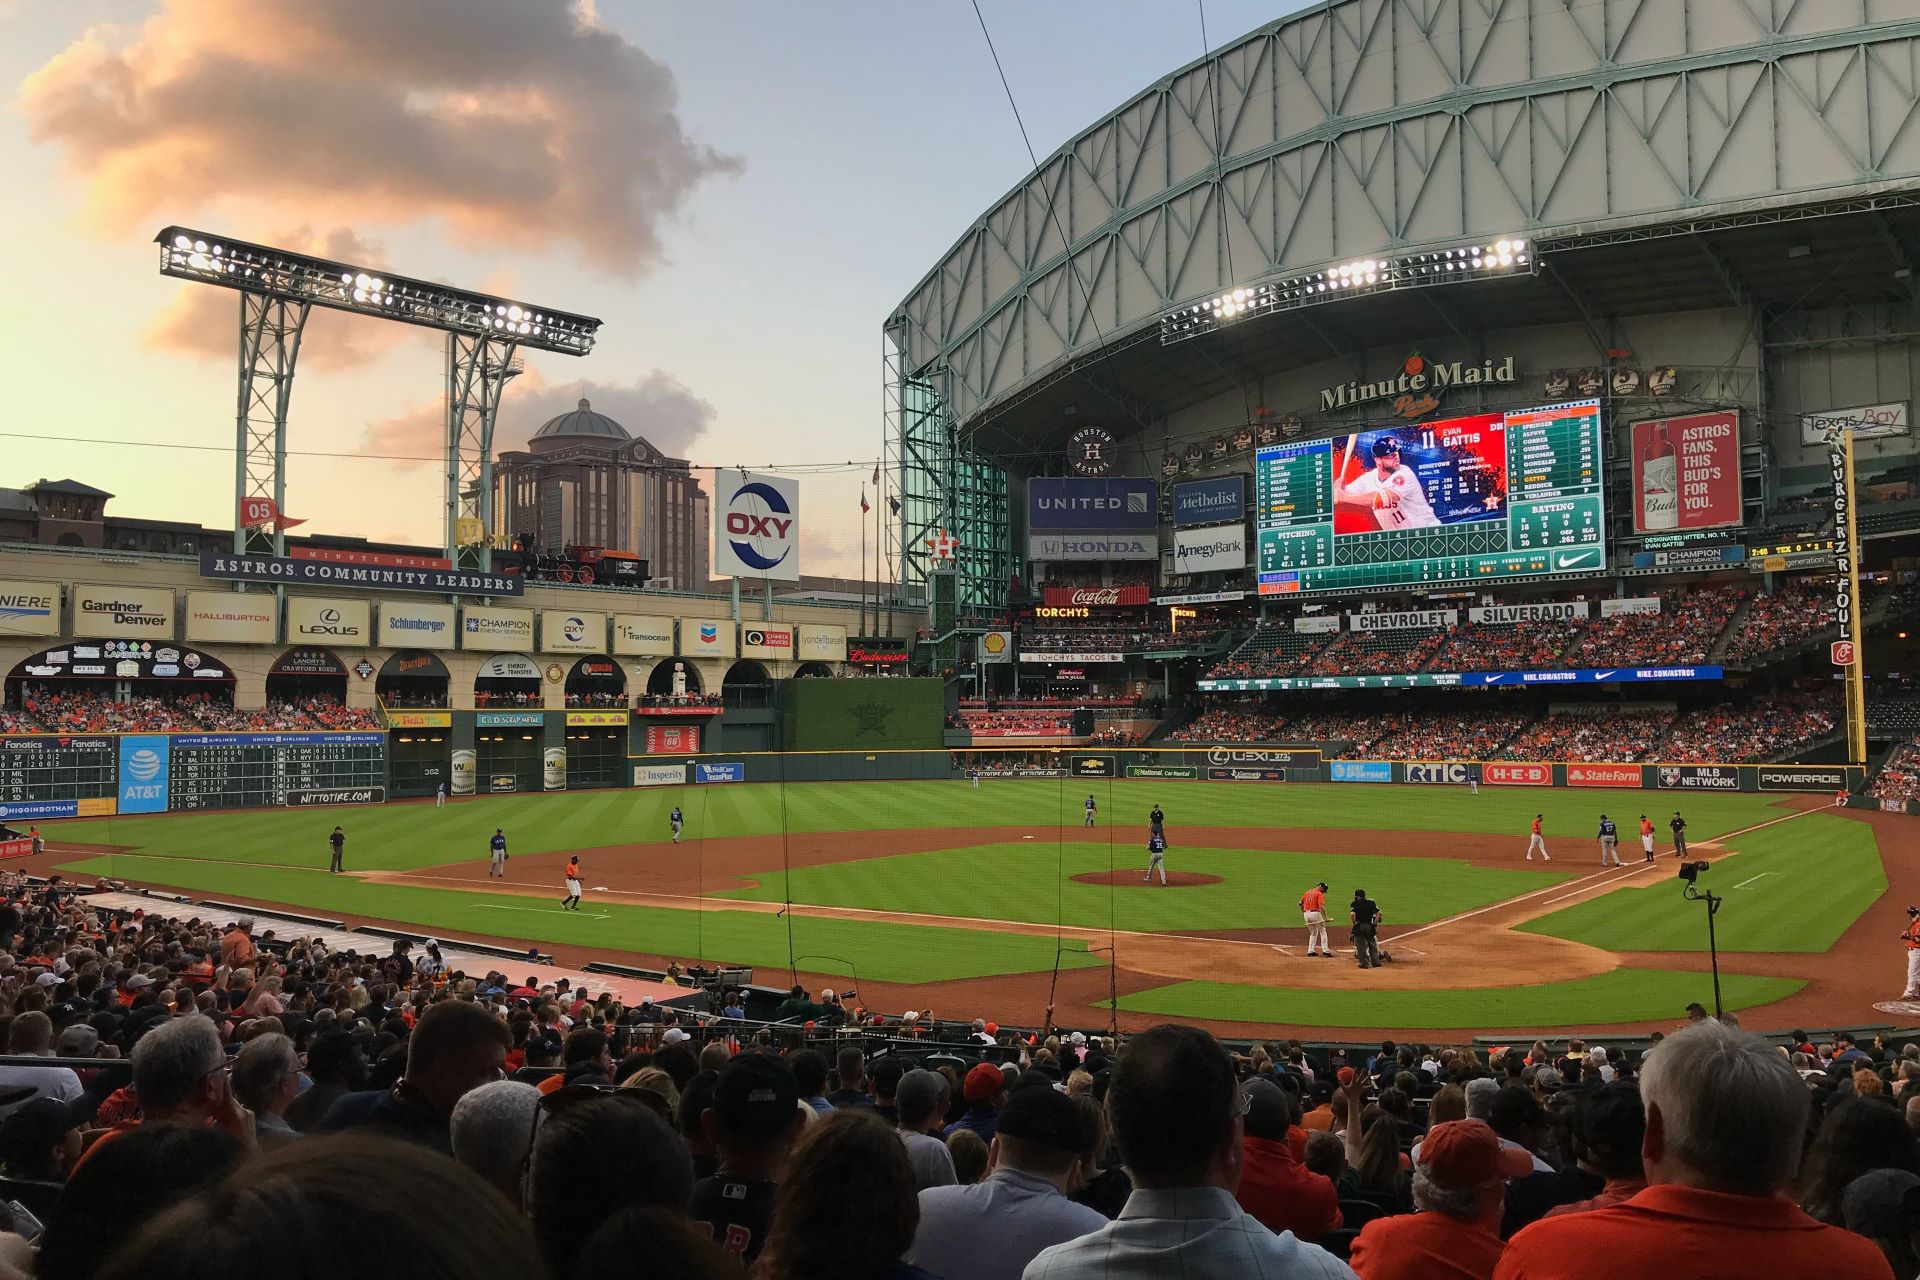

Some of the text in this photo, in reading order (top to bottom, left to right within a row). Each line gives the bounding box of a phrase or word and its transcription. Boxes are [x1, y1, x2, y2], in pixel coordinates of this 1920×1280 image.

[1319, 356, 1517, 413] Minute Maid
[1809, 408, 1900, 431] Texas Bay
[1443, 427, 1461, 437] EVAN
[1490, 423, 1504, 431] DH
[1682, 424, 1731, 440] ASTROS
[1073, 428, 1112, 443] HOUSTON
[1422, 430, 1435, 449] 11
[1443, 433, 1480, 447] GATTIS
[1083, 443, 1101, 460] H
[1279, 448, 1309, 457] TEXAS
[1682, 440, 1717, 454] FANS,
[1075, 461, 1110, 474] ASTROS
[1683, 454, 1711, 468] THIS
[1683, 467, 1721, 482] BUD'S
[1684, 483, 1708, 496] FOR
[1038, 497, 1121, 510] UNITED
[1179, 491, 1238, 510] Methodist
[1684, 497, 1713, 510] YOU.
[1830, 453, 1848, 554] BURGERZ
[248, 503, 270, 519] 05
[1531, 502, 1575, 514] BATTING
[461, 524, 479, 538] 17
[726, 512, 793, 539] OXY
[1278, 529, 1316, 540] PITCHING
[1559, 536, 1575, 544] .262
[1581, 534, 1597, 542] .277
[1645, 534, 1682, 543] DESIGNATED
[1062, 542, 1147, 553] HONDA
[1177, 540, 1241, 559] AmegyBank
[1669, 549, 1721, 559] CHAMPION
[1776, 545, 1792, 554] TEX
[309, 551, 438, 567] MINUTE MAID
[1751, 562, 1764, 570] the
[1785, 556, 1825, 568] generation
[213, 558, 515, 591] ASTROS COMMUNITY LEADERS
[1266, 583, 1291, 592] ASTROS
[0, 595, 52, 608] NIERE
[1072, 589, 1120, 605] Coca-Cola
[82, 599, 143, 613] Gardner
[1036, 607, 1089, 618] TORCHYS
[1835, 579, 1851, 638] FOUL
[113, 613, 167, 626] Denver
[194, 612, 270, 622] HALLIBURTON
[1359, 611, 1447, 629] CHEVROLET
[1482, 604, 1575, 624] SILVERADO
[390, 616, 445, 633] Schlumberger
[480, 618, 530, 629] CHAMPION
[564, 625, 585, 633] OXY
[299, 624, 359, 637] LEXUS
[628, 631, 671, 642] Transocean
[103, 650, 152, 659] LANDRY'S
[849, 650, 909, 663] Budweiser
[293, 658, 326, 666] LANDRY'S
[1523, 672, 1576, 682] NIKE.COM/ASTROS
[1637, 669, 1695, 678] NIKE.COM/ASTROS
[501, 716, 540, 724] SCRAP METAL
[1002, 728, 1041, 737] Budweiser
[5, 739, 107, 749] Fanatics Fanatics
[666, 737, 678, 746] 66
[424, 768, 440, 776] 362
[648, 770, 683, 781] Insperity
[1406, 763, 1467, 782] RTIC
[1493, 768, 1542, 780] H-E-B
[1660, 767, 1679, 775] MLB
[1696, 767, 1721, 777] MLB
[1681, 776, 1736, 787] NETWORK
[1761, 774, 1842, 784] POWERADE
[124, 785, 163, 801] AT&T
[300, 790, 372, 804] NITTOTIRE.COM
[9, 805, 74, 814] HIGGINBOTHAM
